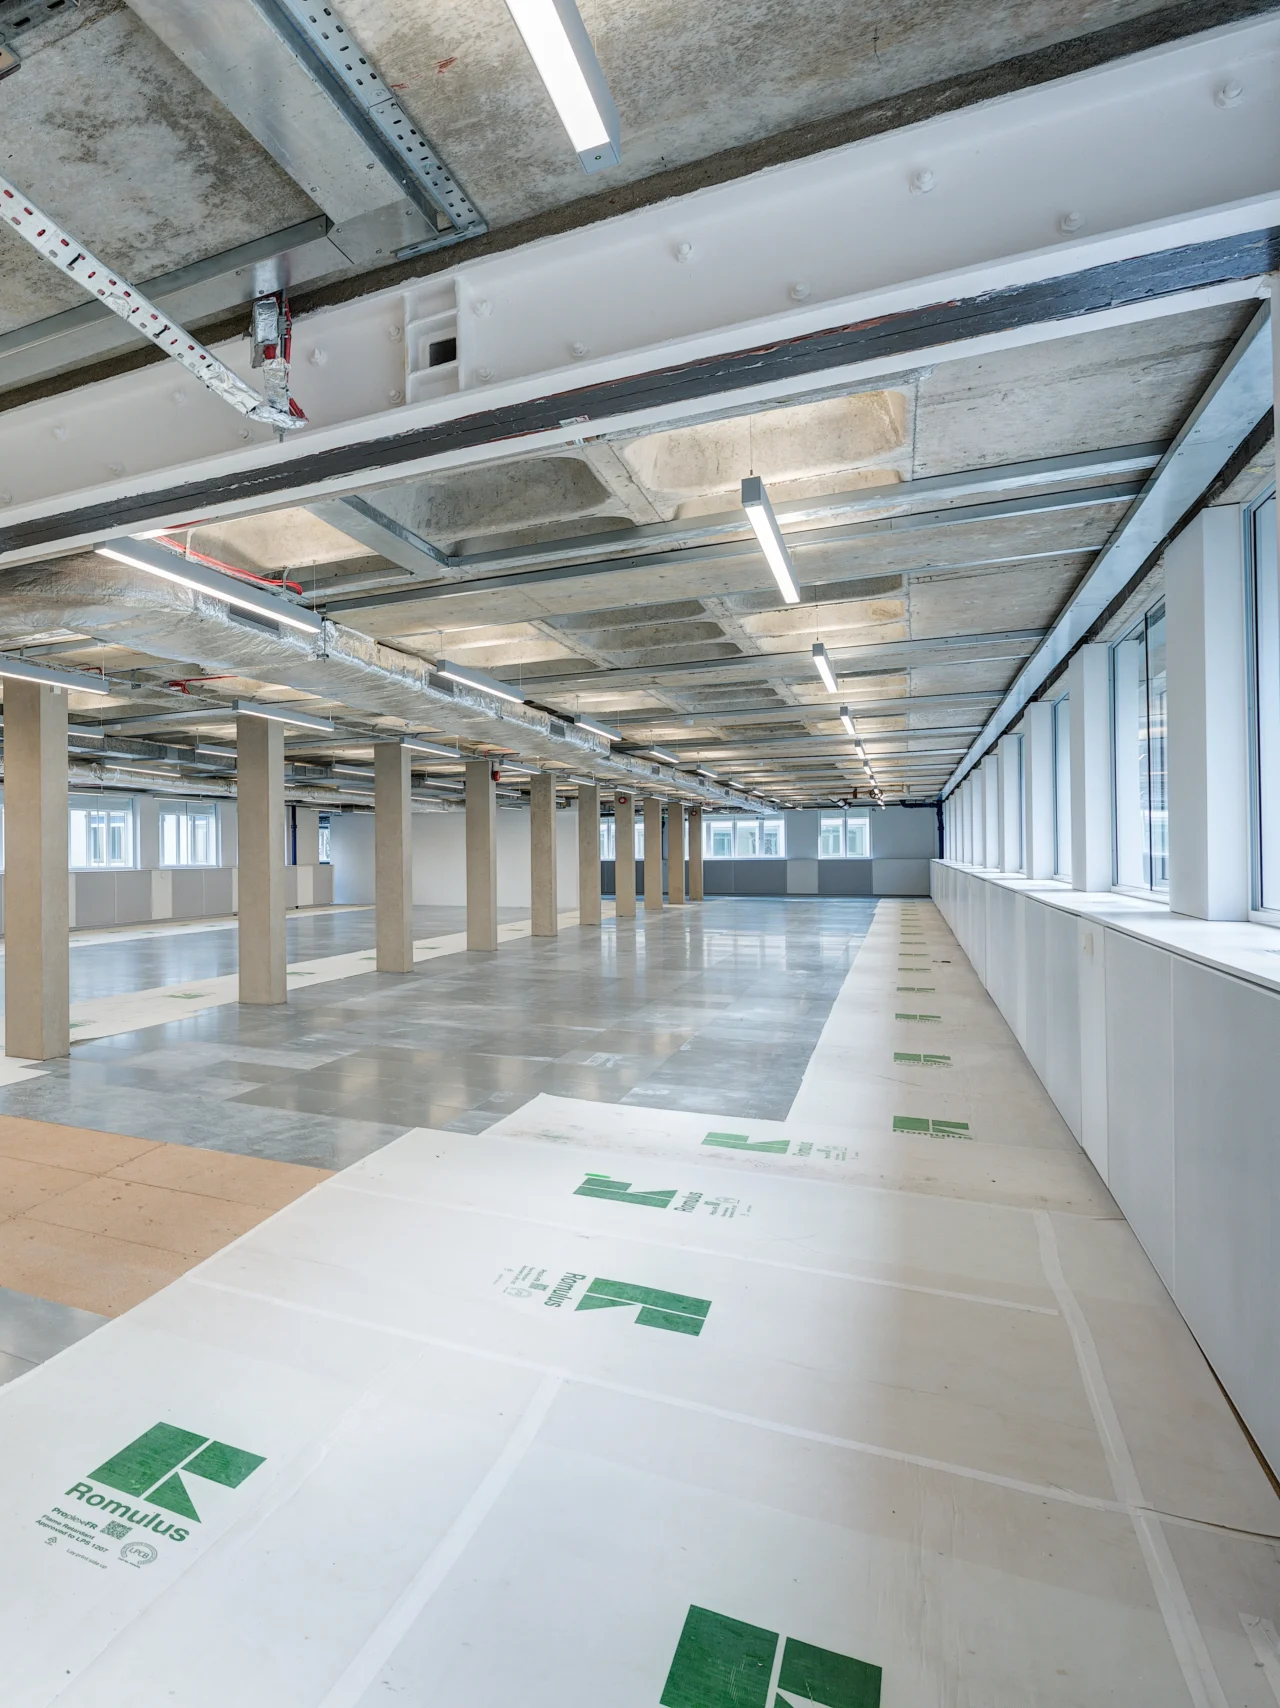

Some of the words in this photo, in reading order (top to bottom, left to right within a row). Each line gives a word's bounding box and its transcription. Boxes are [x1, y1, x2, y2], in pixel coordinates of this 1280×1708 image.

[674, 1191, 704, 1213] Romulus
[543, 1271, 587, 1308] Romulus
[64, 1481, 190, 1542] Romulus
[35, 1519, 69, 1536] Approved
[75, 1536, 91, 1546] LPS
[91, 1543, 109, 1553] 1207
[41, 1514, 62, 1526] Flame
[62, 1523, 96, 1540] Retardant
[66, 1548, 76, 1556] Lay
[128, 1547, 150, 1559] LPCB
